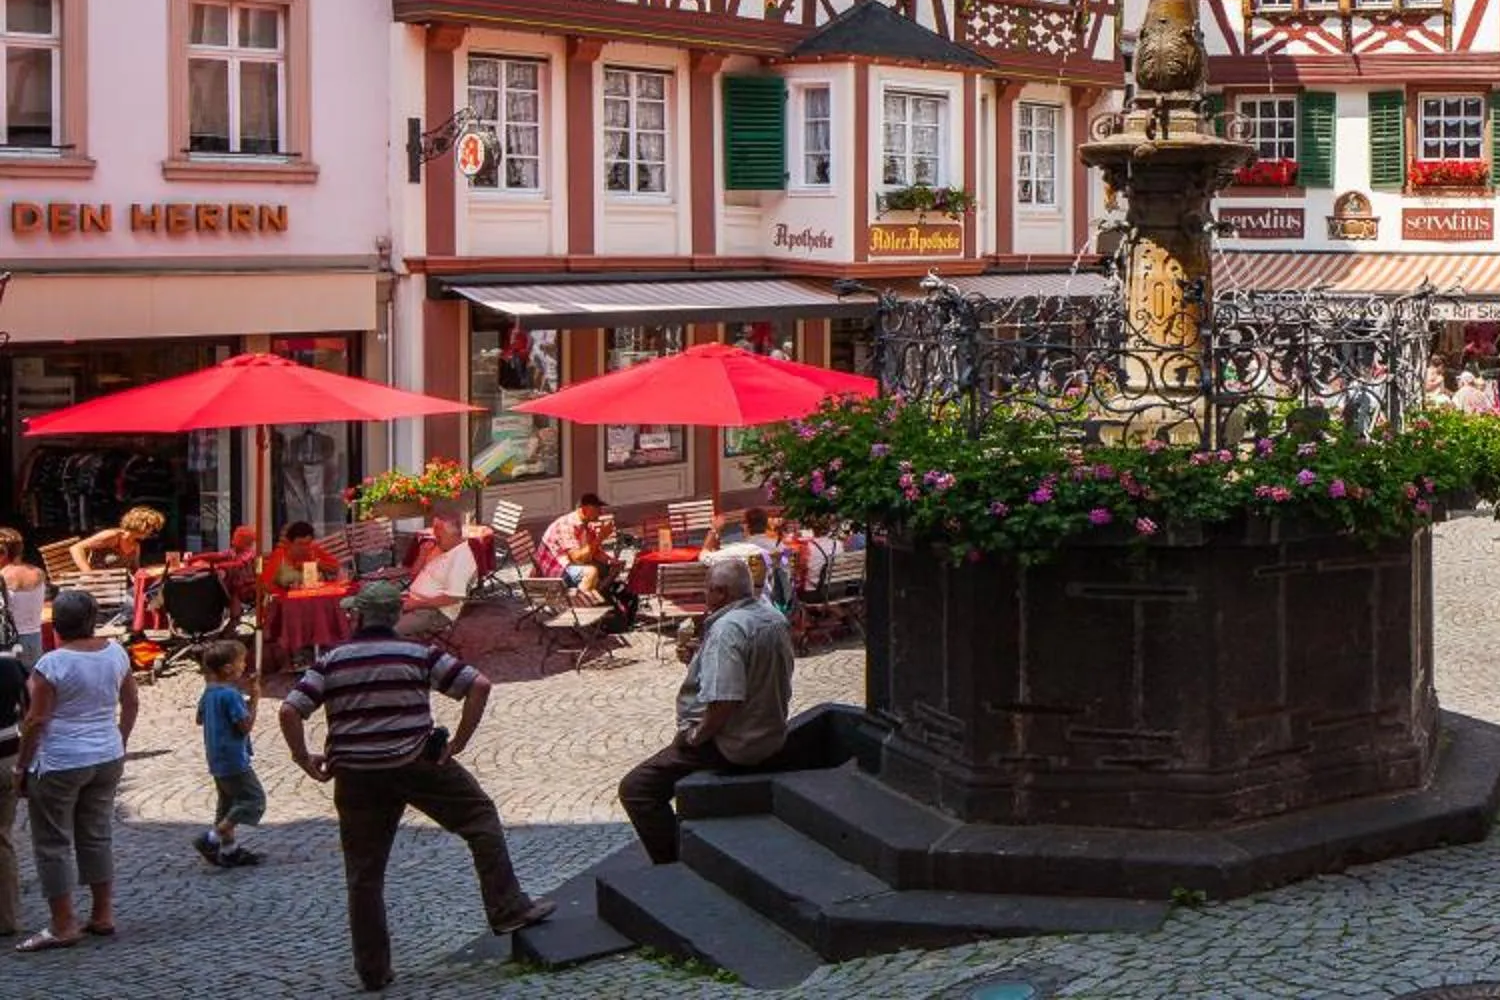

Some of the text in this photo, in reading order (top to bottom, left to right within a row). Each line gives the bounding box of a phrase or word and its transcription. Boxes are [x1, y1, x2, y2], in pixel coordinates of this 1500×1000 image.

[11, 202, 288, 233] DEN HERRN
[1406, 209, 1491, 231] servatius
[773, 223, 835, 252] Apotheke
